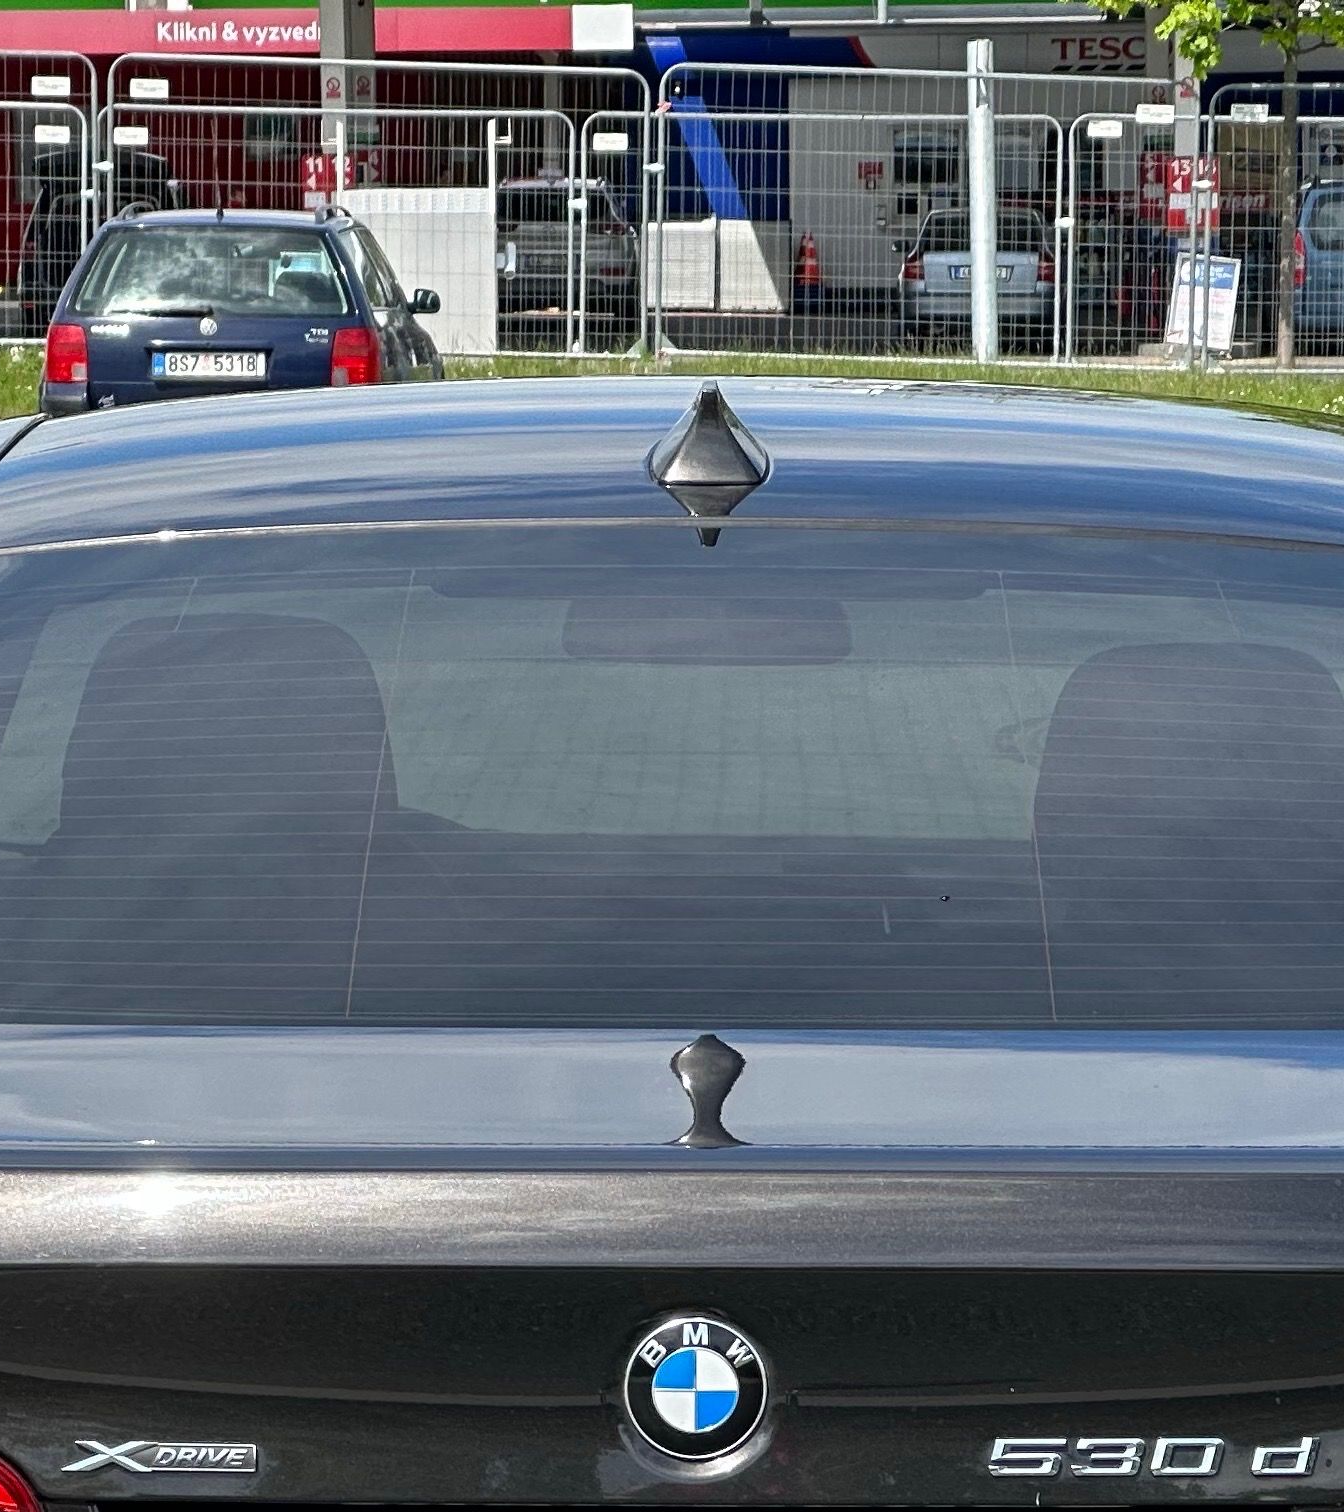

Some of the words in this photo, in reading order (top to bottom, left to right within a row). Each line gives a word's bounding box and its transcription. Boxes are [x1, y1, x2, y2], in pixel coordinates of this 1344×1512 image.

[157, 21, 217, 42] Klikni
[222, 20, 238, 41] &
[243, 21, 321, 47] vyzved
[1051, 36, 1173, 60] TESC
[306, 157, 323, 173] 11
[1171, 160, 1191, 175] 13
[169, 355, 199, 372] 8S7
[214, 355, 256, 372] 5318
[639, 1323, 755, 1368] BMW
[989, 1437, 1224, 1477] 530
[1250, 1437, 1321, 1477] d
